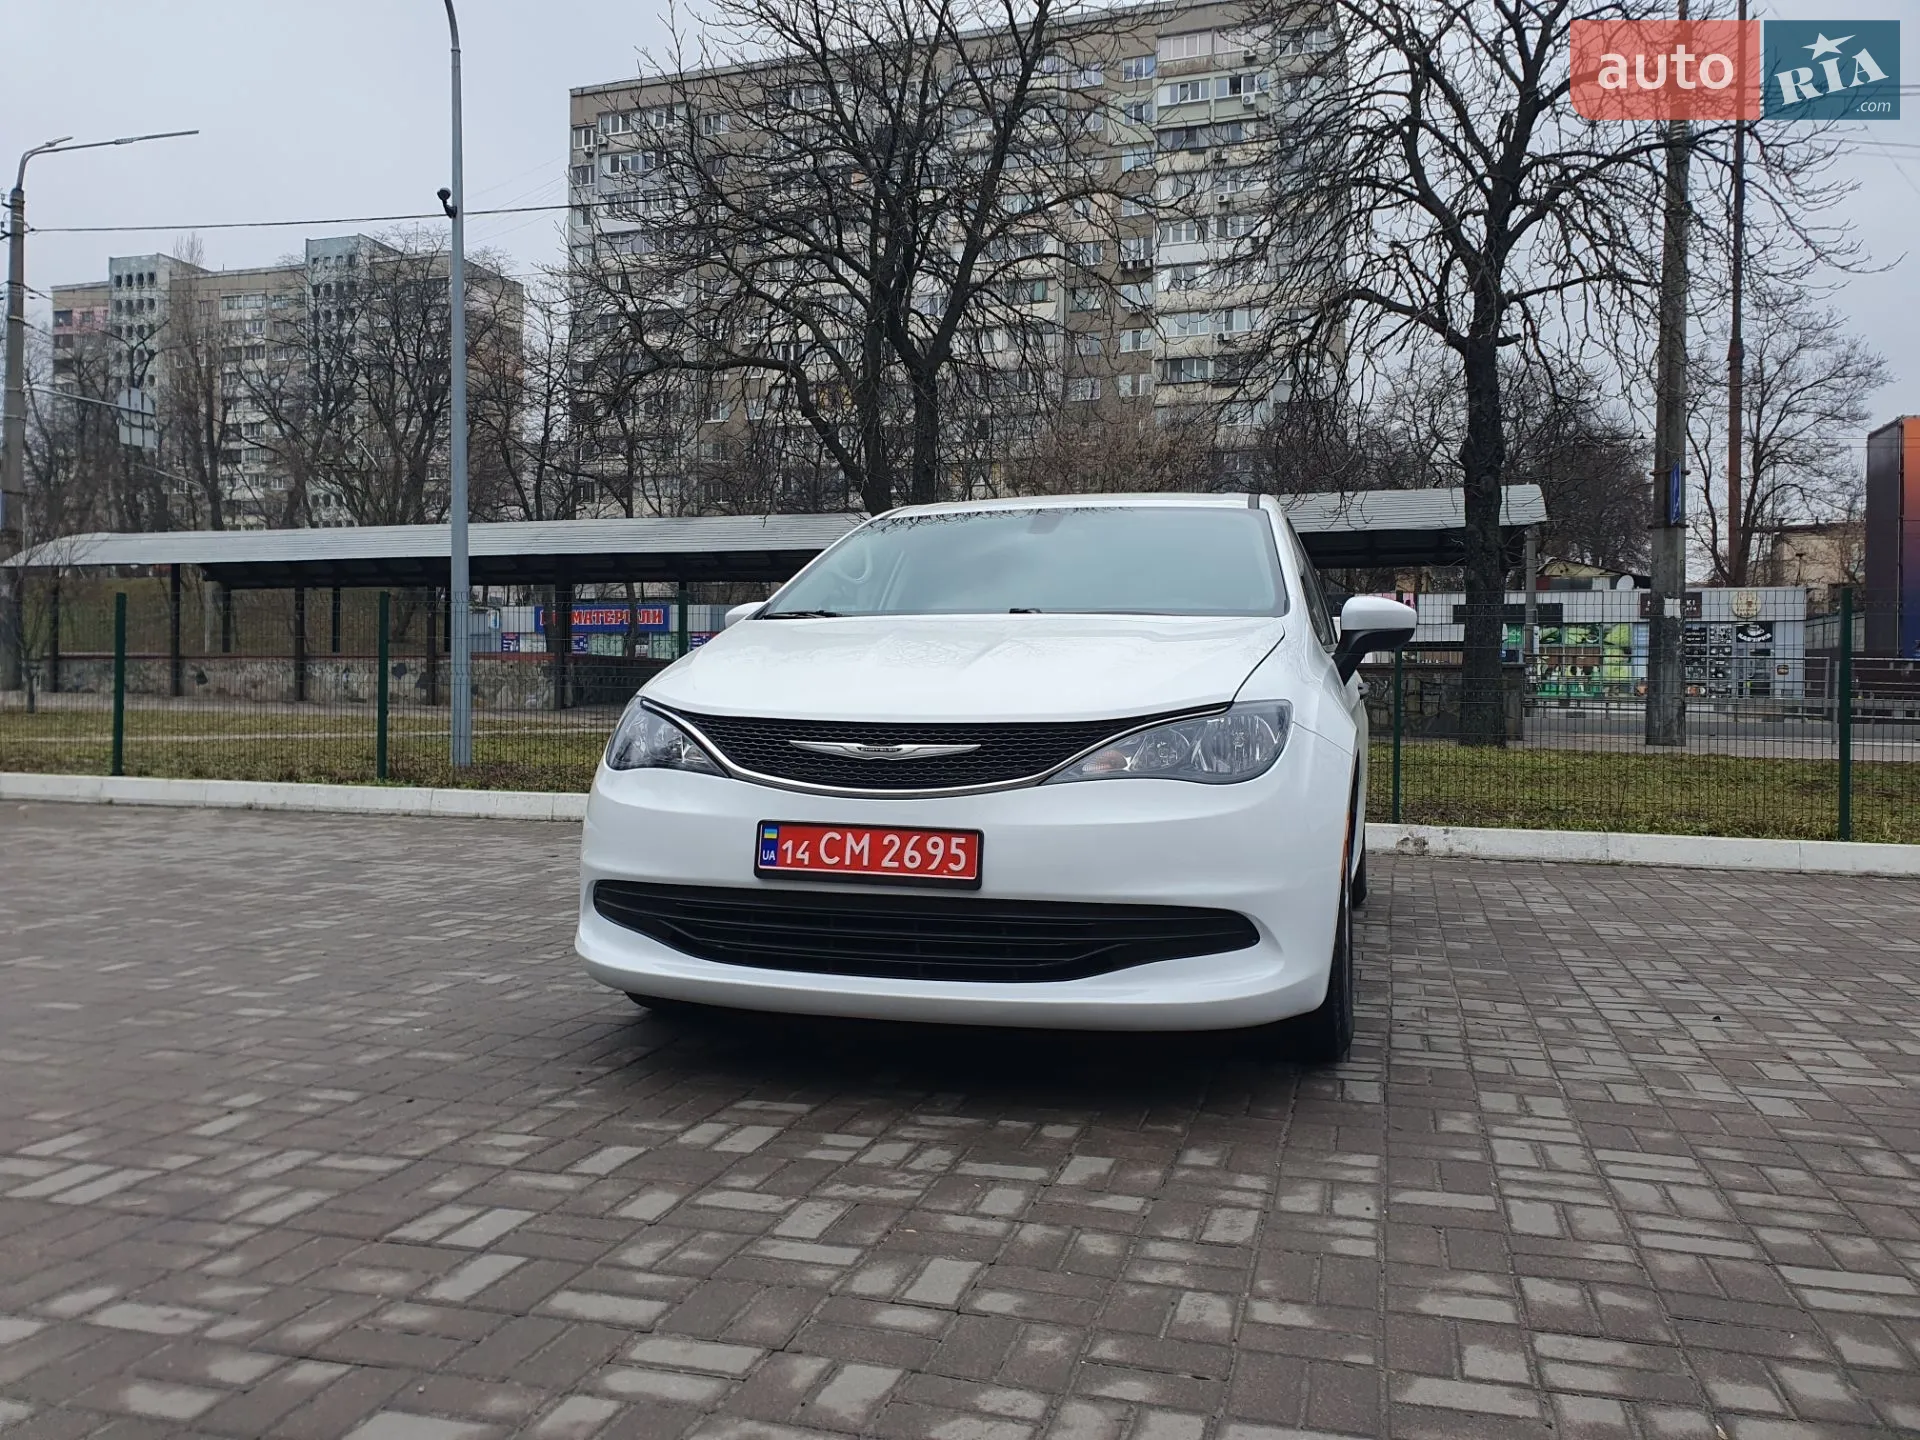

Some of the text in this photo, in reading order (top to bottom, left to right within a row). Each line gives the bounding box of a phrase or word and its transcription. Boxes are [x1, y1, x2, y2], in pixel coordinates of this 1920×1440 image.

[762, 850, 776, 861] UA
[782, 831, 967, 872] 14 CM 2695
